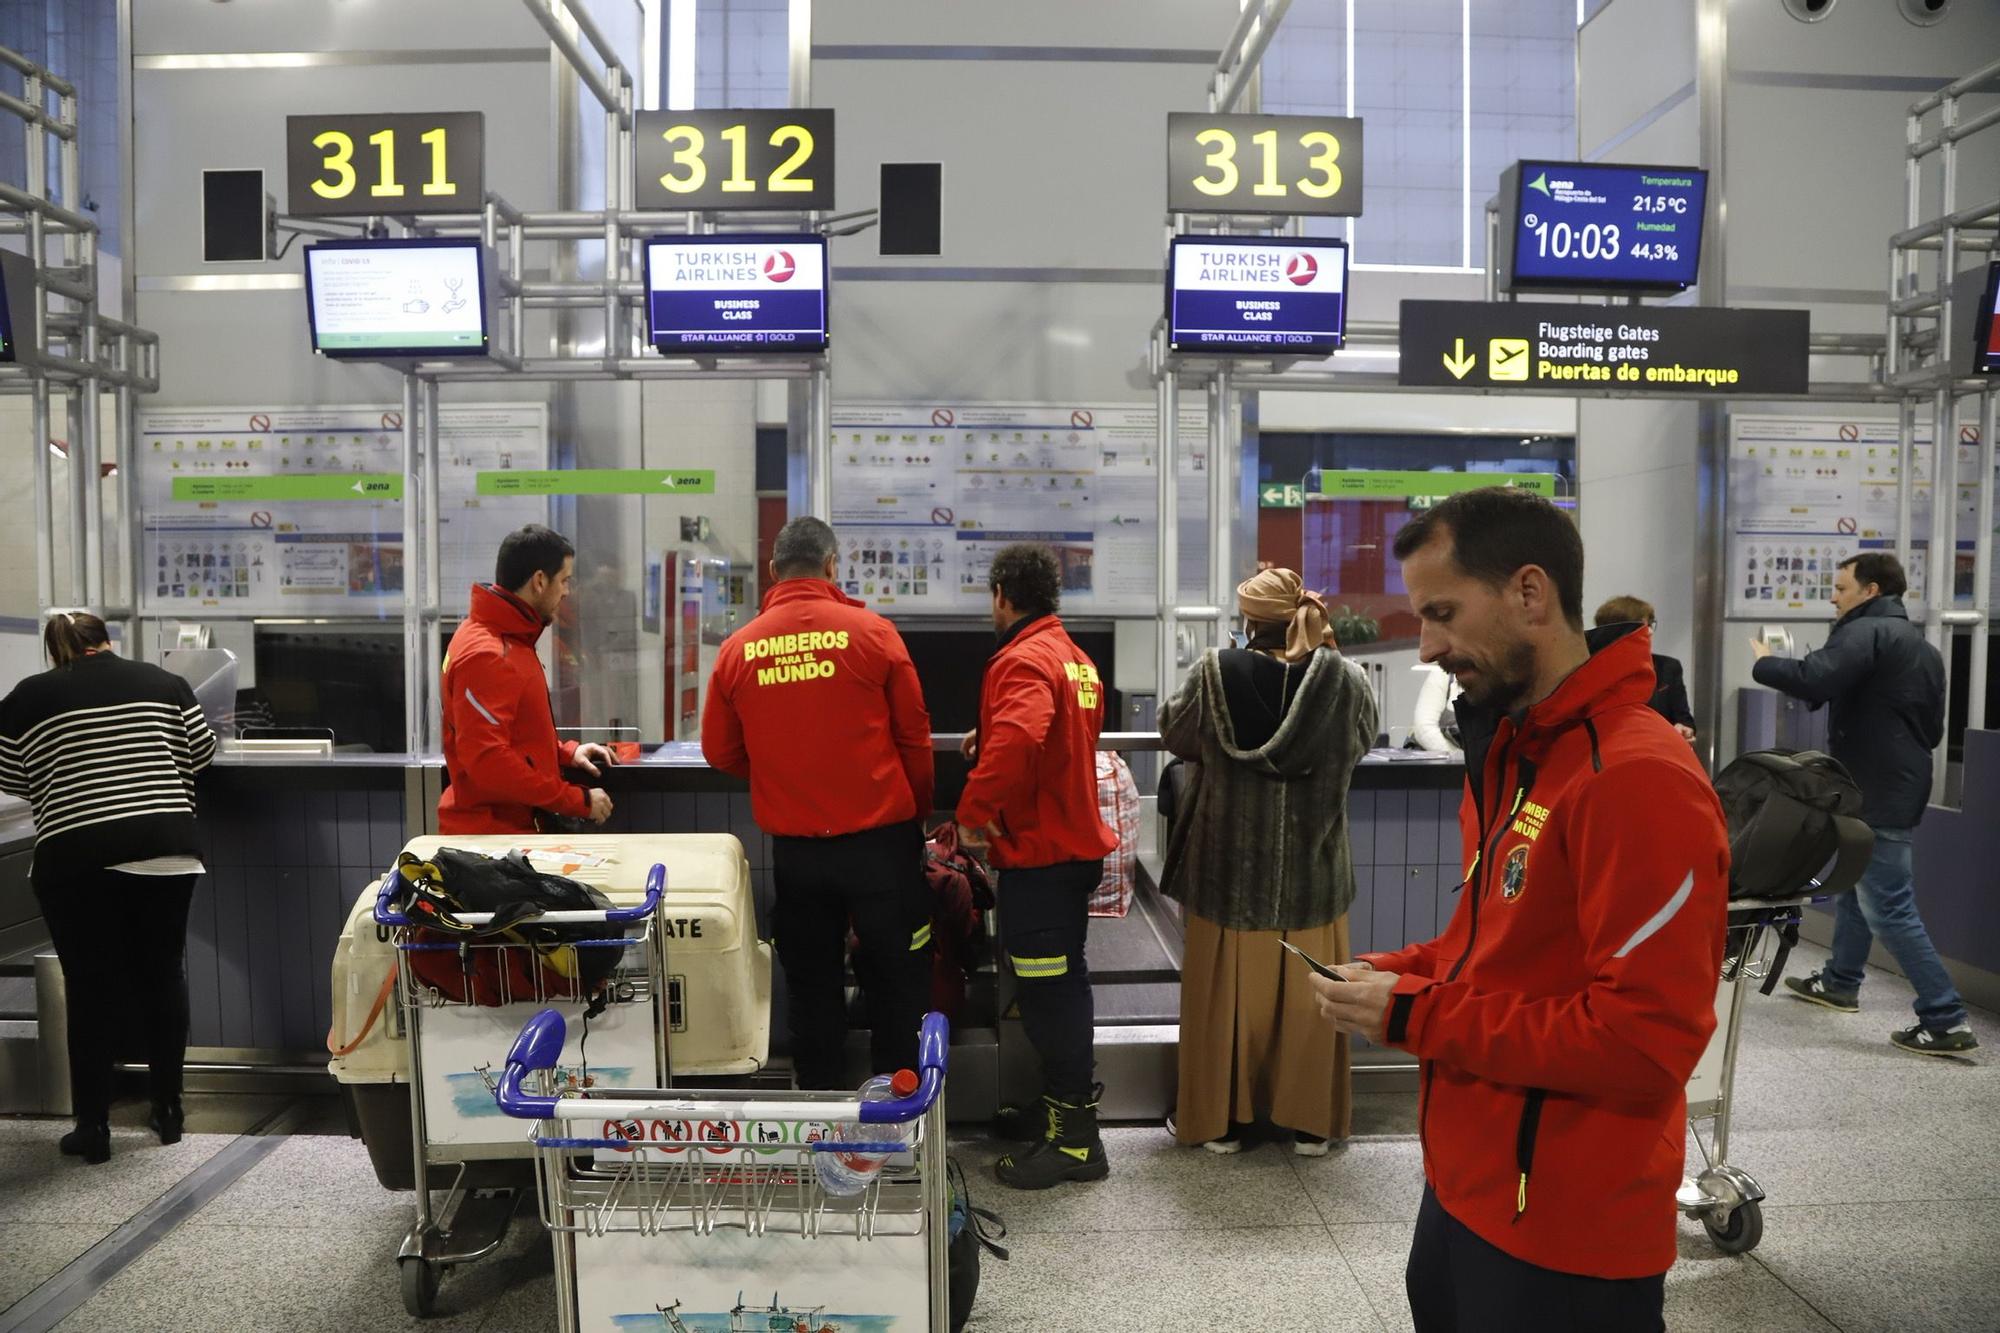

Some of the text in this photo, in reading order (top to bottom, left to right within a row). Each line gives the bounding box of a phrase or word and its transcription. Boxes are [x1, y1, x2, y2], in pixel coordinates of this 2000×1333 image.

[310, 128, 456, 199] 311
[659, 125, 814, 193] 312
[1192, 128, 1342, 198] 313
[1549, 180, 1574, 189] aena
[1641, 175, 1692, 187] Temperatura
[1632, 195, 1666, 213] 21,5
[1636, 221, 1676, 233] Humedad
[1535, 221, 1620, 260] 10:03
[1630, 242, 1679, 261] 44,3%
[675, 252, 757, 266] TURKISH
[1200, 252, 1281, 266] TURKISH
[675, 268, 757, 281] AIRLINES
[1199, 269, 1280, 283] AIRLINES
[714, 300, 760, 309] BUSINESS
[1236, 300, 1281, 310] BUSINESS
[722, 311, 753, 320] CLASS
[1243, 312, 1273, 321] CLASS
[681, 334, 795, 342] STAR ALLIANCE GOLD
[1201, 333, 1313, 343] STAR ALLIANCE GOLD
[1539, 322, 1659, 342] Flugsteige Gates
[1539, 341, 1649, 361] Boarding gates
[1539, 361, 1739, 386] Puertas de embarque
[366, 480, 390, 491] aena
[676, 476, 701, 486] aena
[744, 631, 849, 662] BOMBEROS
[775, 652, 816, 666] PARA EL
[757, 660, 835, 686] MUNDO
[1512, 819, 1541, 841] MUN
